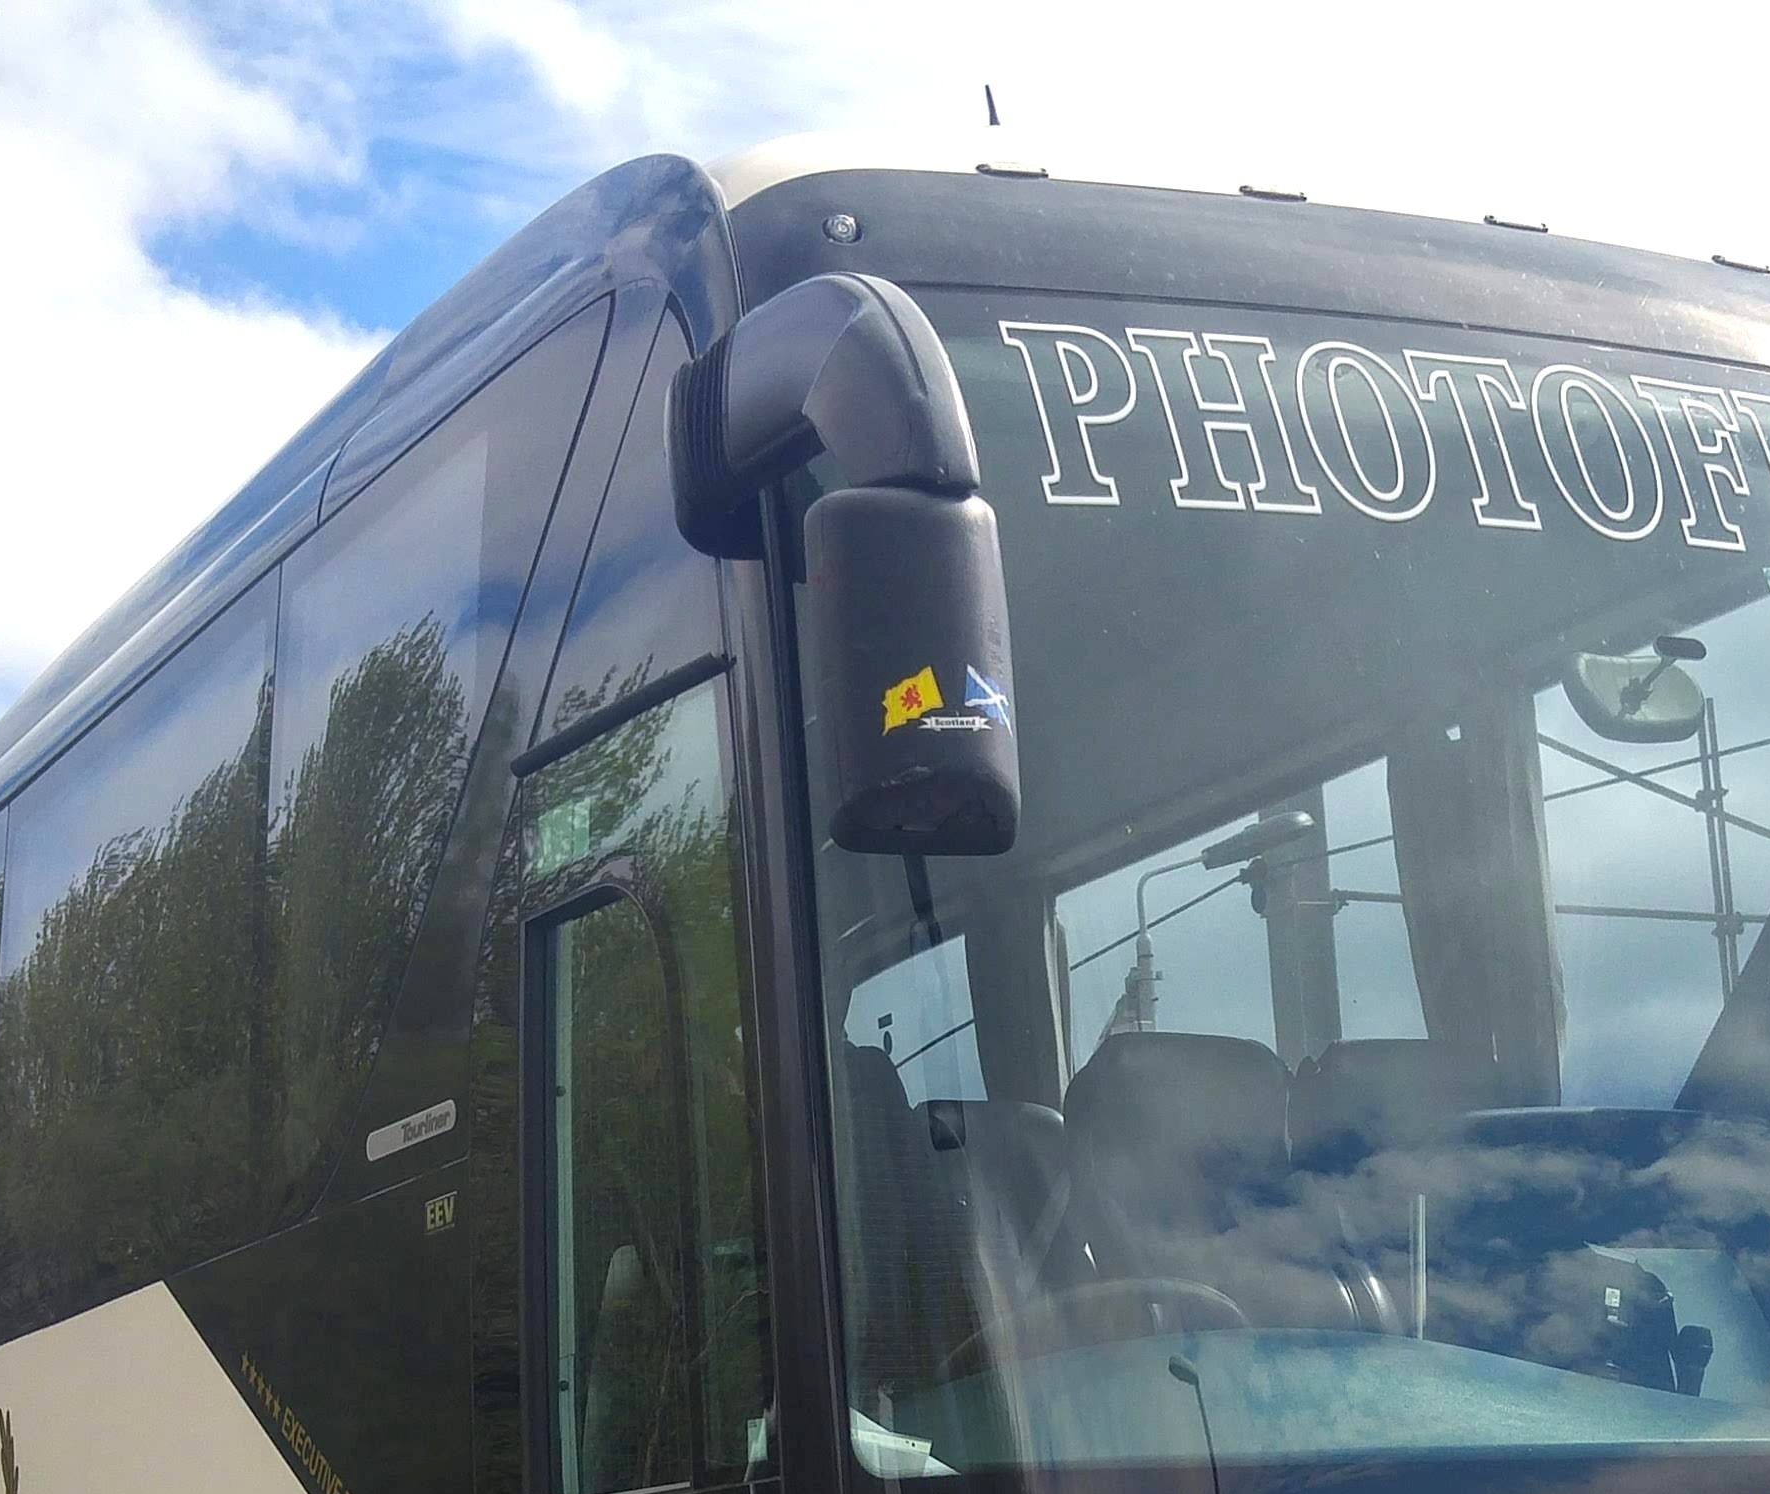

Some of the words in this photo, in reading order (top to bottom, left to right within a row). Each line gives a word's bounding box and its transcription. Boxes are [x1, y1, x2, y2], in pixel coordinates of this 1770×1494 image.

[934, 718, 976, 726] Scotland
[401, 1111, 450, 1143] Tourliner
[426, 1196, 455, 1230] EEV
